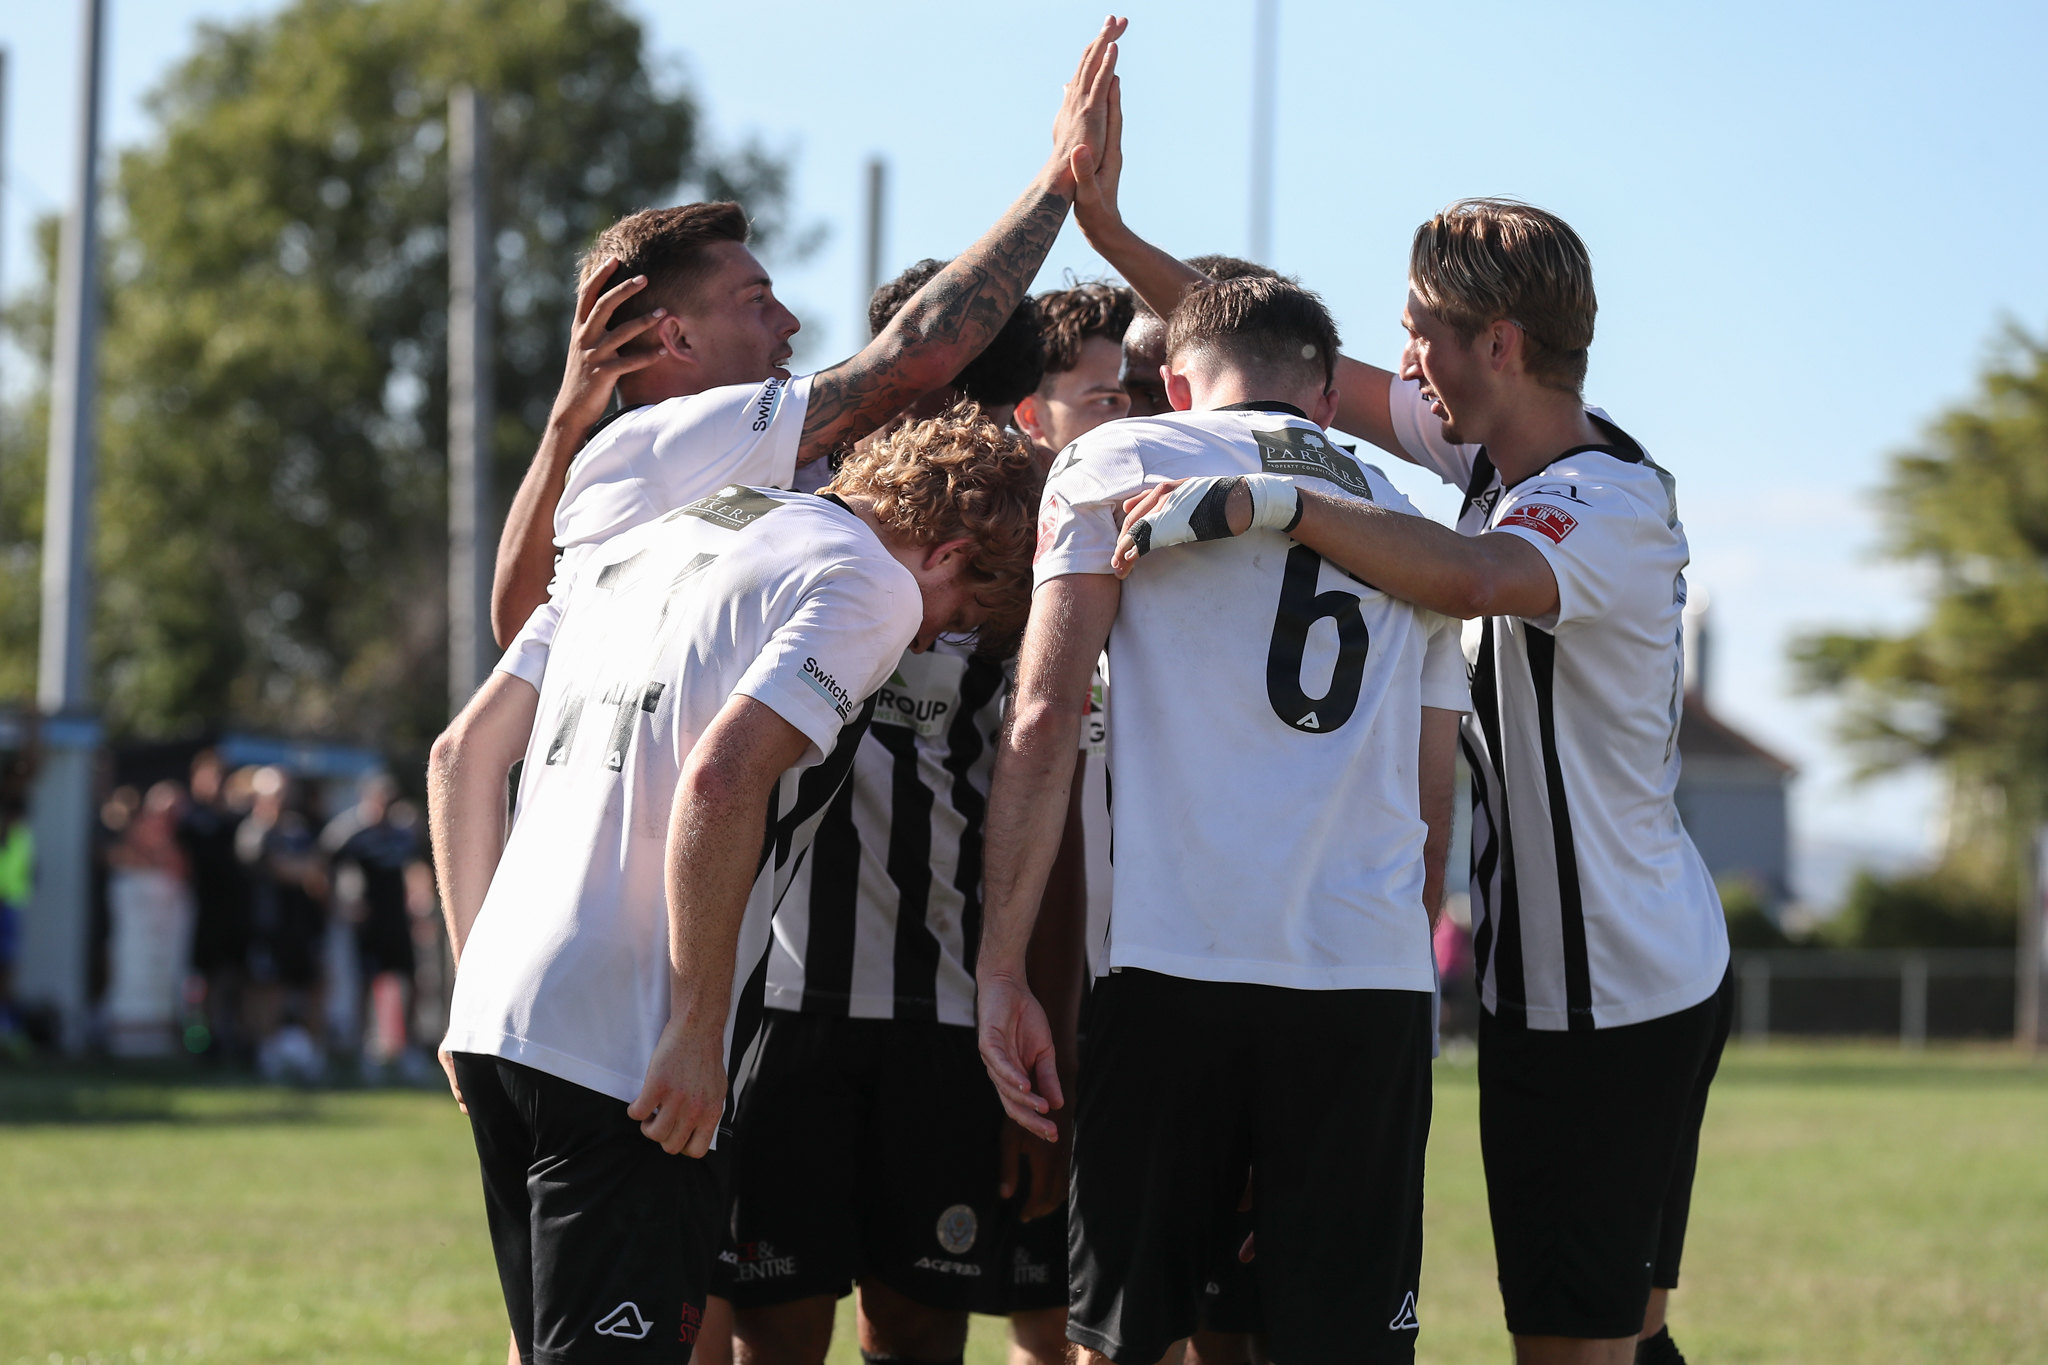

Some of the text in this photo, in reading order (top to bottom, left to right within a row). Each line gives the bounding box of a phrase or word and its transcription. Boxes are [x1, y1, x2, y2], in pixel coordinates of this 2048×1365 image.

[1266, 446, 1365, 487] PARKERS
[1535, 509, 1551, 521] IN
[1266, 540, 1370, 733] 6
